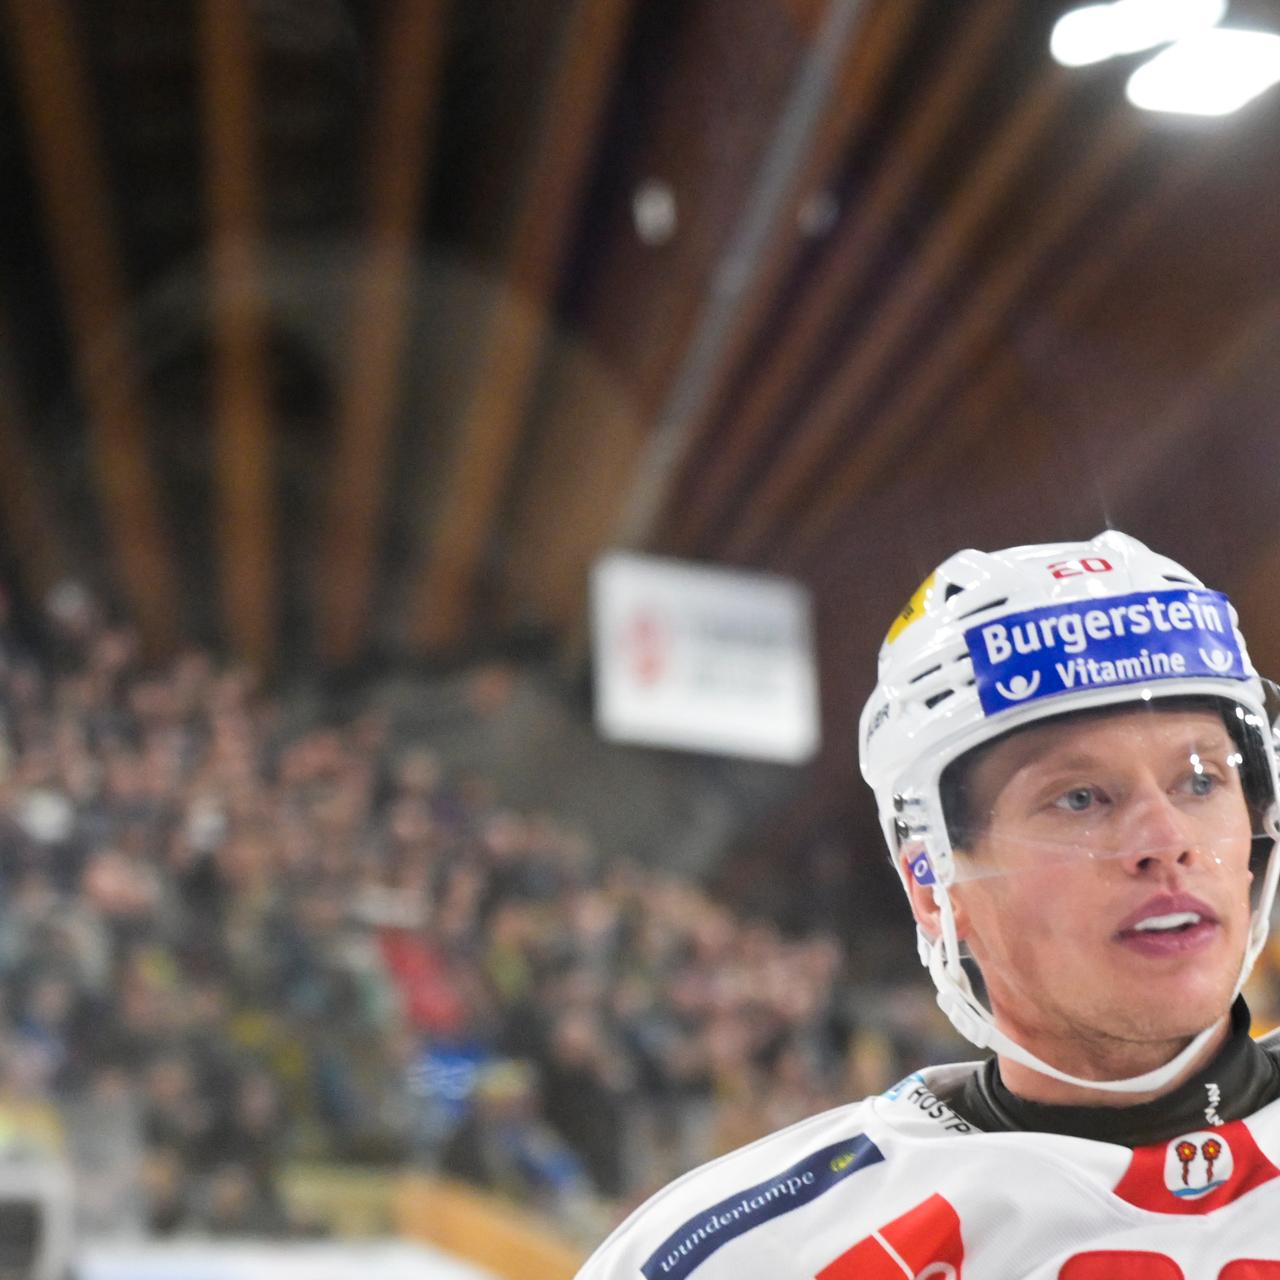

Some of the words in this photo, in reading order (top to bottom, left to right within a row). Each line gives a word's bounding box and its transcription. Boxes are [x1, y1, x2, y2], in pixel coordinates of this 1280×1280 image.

[982, 592, 1223, 665] Burgerstein
[1055, 649, 1186, 688] Vitamine
[659, 1169, 817, 1274] wunderlampe
